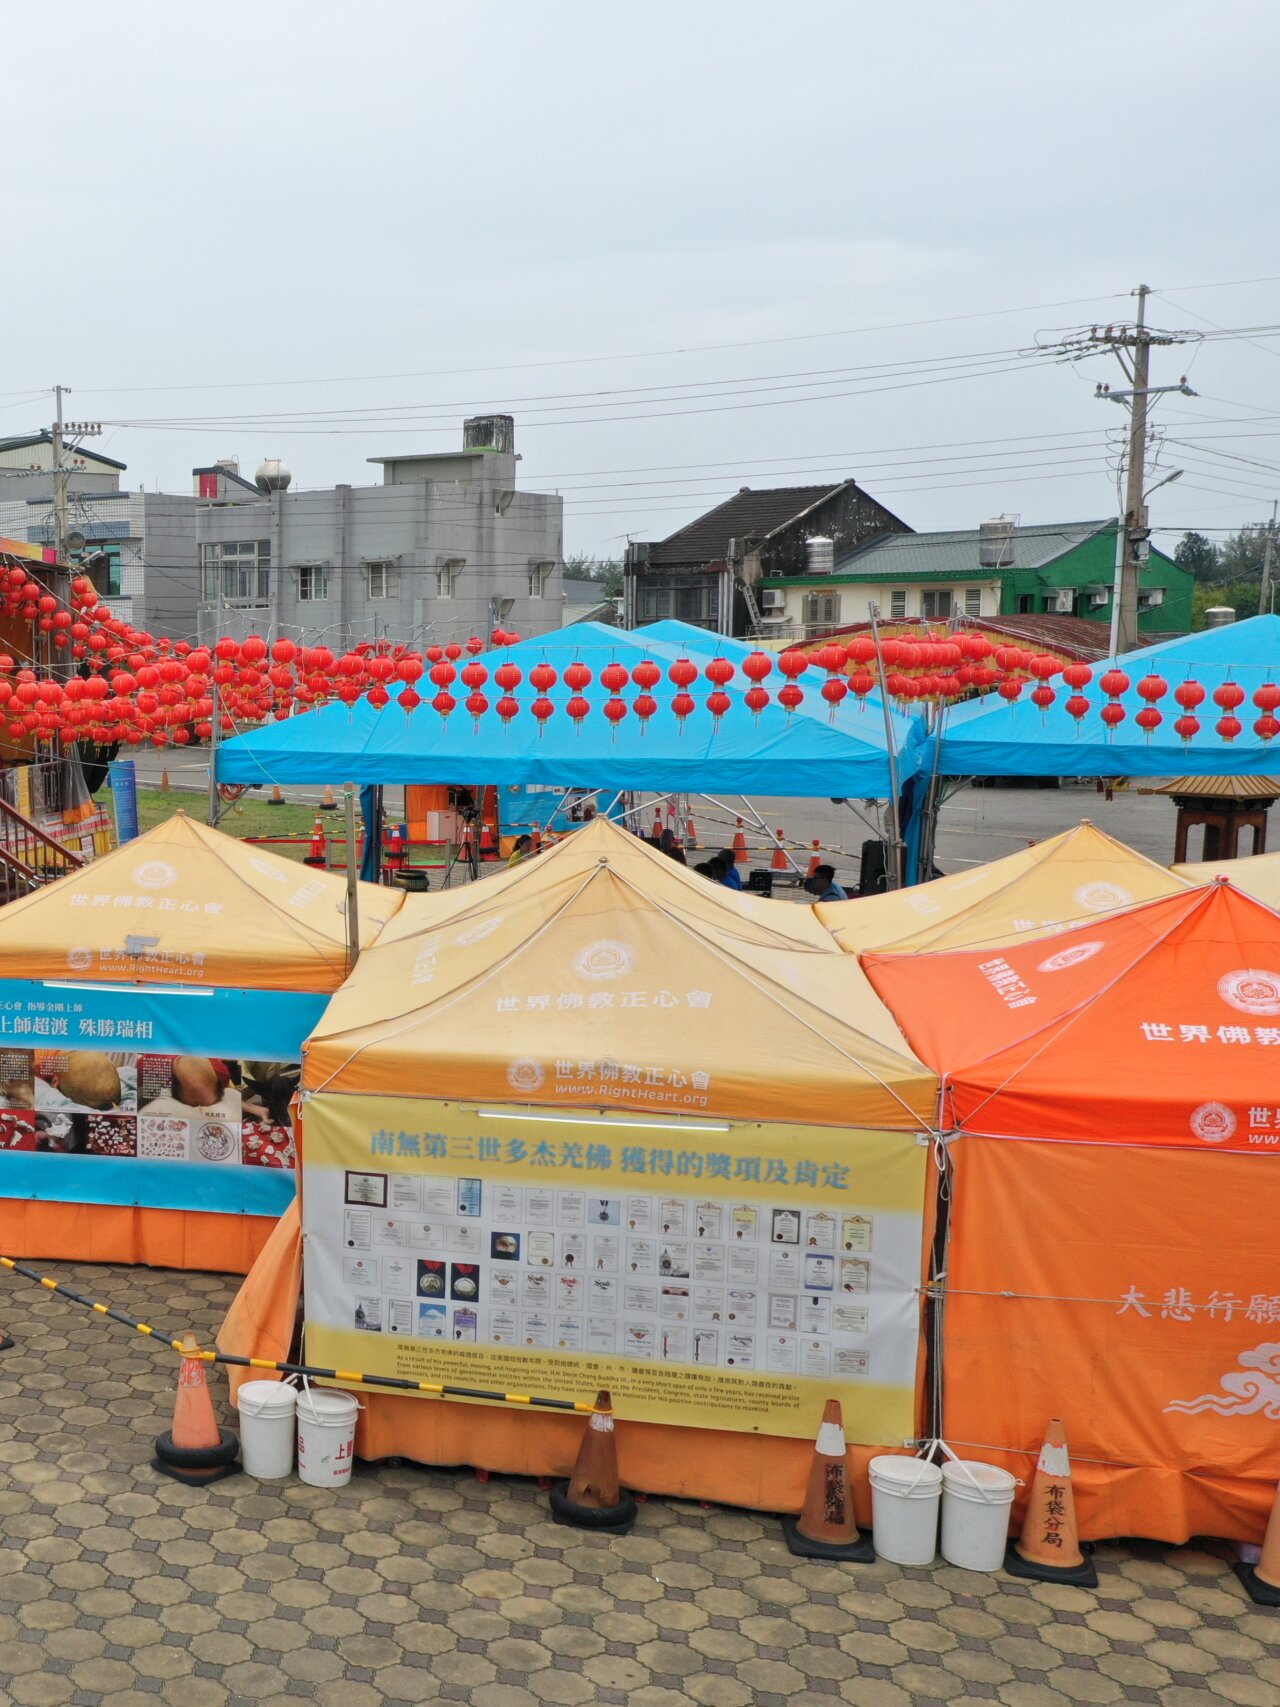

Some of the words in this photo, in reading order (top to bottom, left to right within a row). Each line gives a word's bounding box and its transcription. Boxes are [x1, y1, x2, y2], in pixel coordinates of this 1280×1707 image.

[70, 893, 224, 914] 世界佛教正心會
[99, 963, 205, 977] www.RightHeart.org
[495, 990, 713, 1013] 世界佛教正心會
[78, 1018, 153, 1039] 殊勝瑞相
[553, 1059, 711, 1091] 世界佛教正心會
[554, 1083, 709, 1107] www.RightHeart.org
[370, 1129, 612, 1170] 南無第三世多杰羌佛
[620, 1144, 850, 1190] 獲得的獎項及肯定
[397, 1361, 411, 1369] from
[412, 1363, 432, 1371] various
[433, 1365, 452, 1373] levels
[459, 1368, 497, 1379] governmental
[499, 1372, 521, 1380] entities
[522, 1374, 540, 1382] within
[554, 1378, 574, 1386] United
[575, 1380, 594, 1389] States,
[596, 1382, 610, 1390] such
[632, 1386, 660, 1396] President,
[663, 1389, 690, 1399] Congress,
[693, 1392, 708, 1400] state
[748, 1398, 769, 1407] county
[771, 1400, 792, 1408] boards
[442, 1373, 453, 1382] city
[490, 1378, 505, 1386] other
[547, 1384, 561, 1393] They
[622, 1392, 647, 1400] Holiness
[669, 1397, 692, 1406] positive
[470, 1362, 493, 1372] moving,
[504, 1365, 530, 1376] inspiring
[579, 1373, 597, 1383] Chang
[642, 1381, 655, 1389] very
[655, 1381, 672, 1389] short
[672, 1384, 687, 1392] span
[694, 1385, 708, 1394] only
[725, 1390, 743, 1398] years,
[755, 1391, 781, 1400] received
[782, 1394, 800, 1403] praise
[1042, 1484, 1066, 1548] 布袋分局
